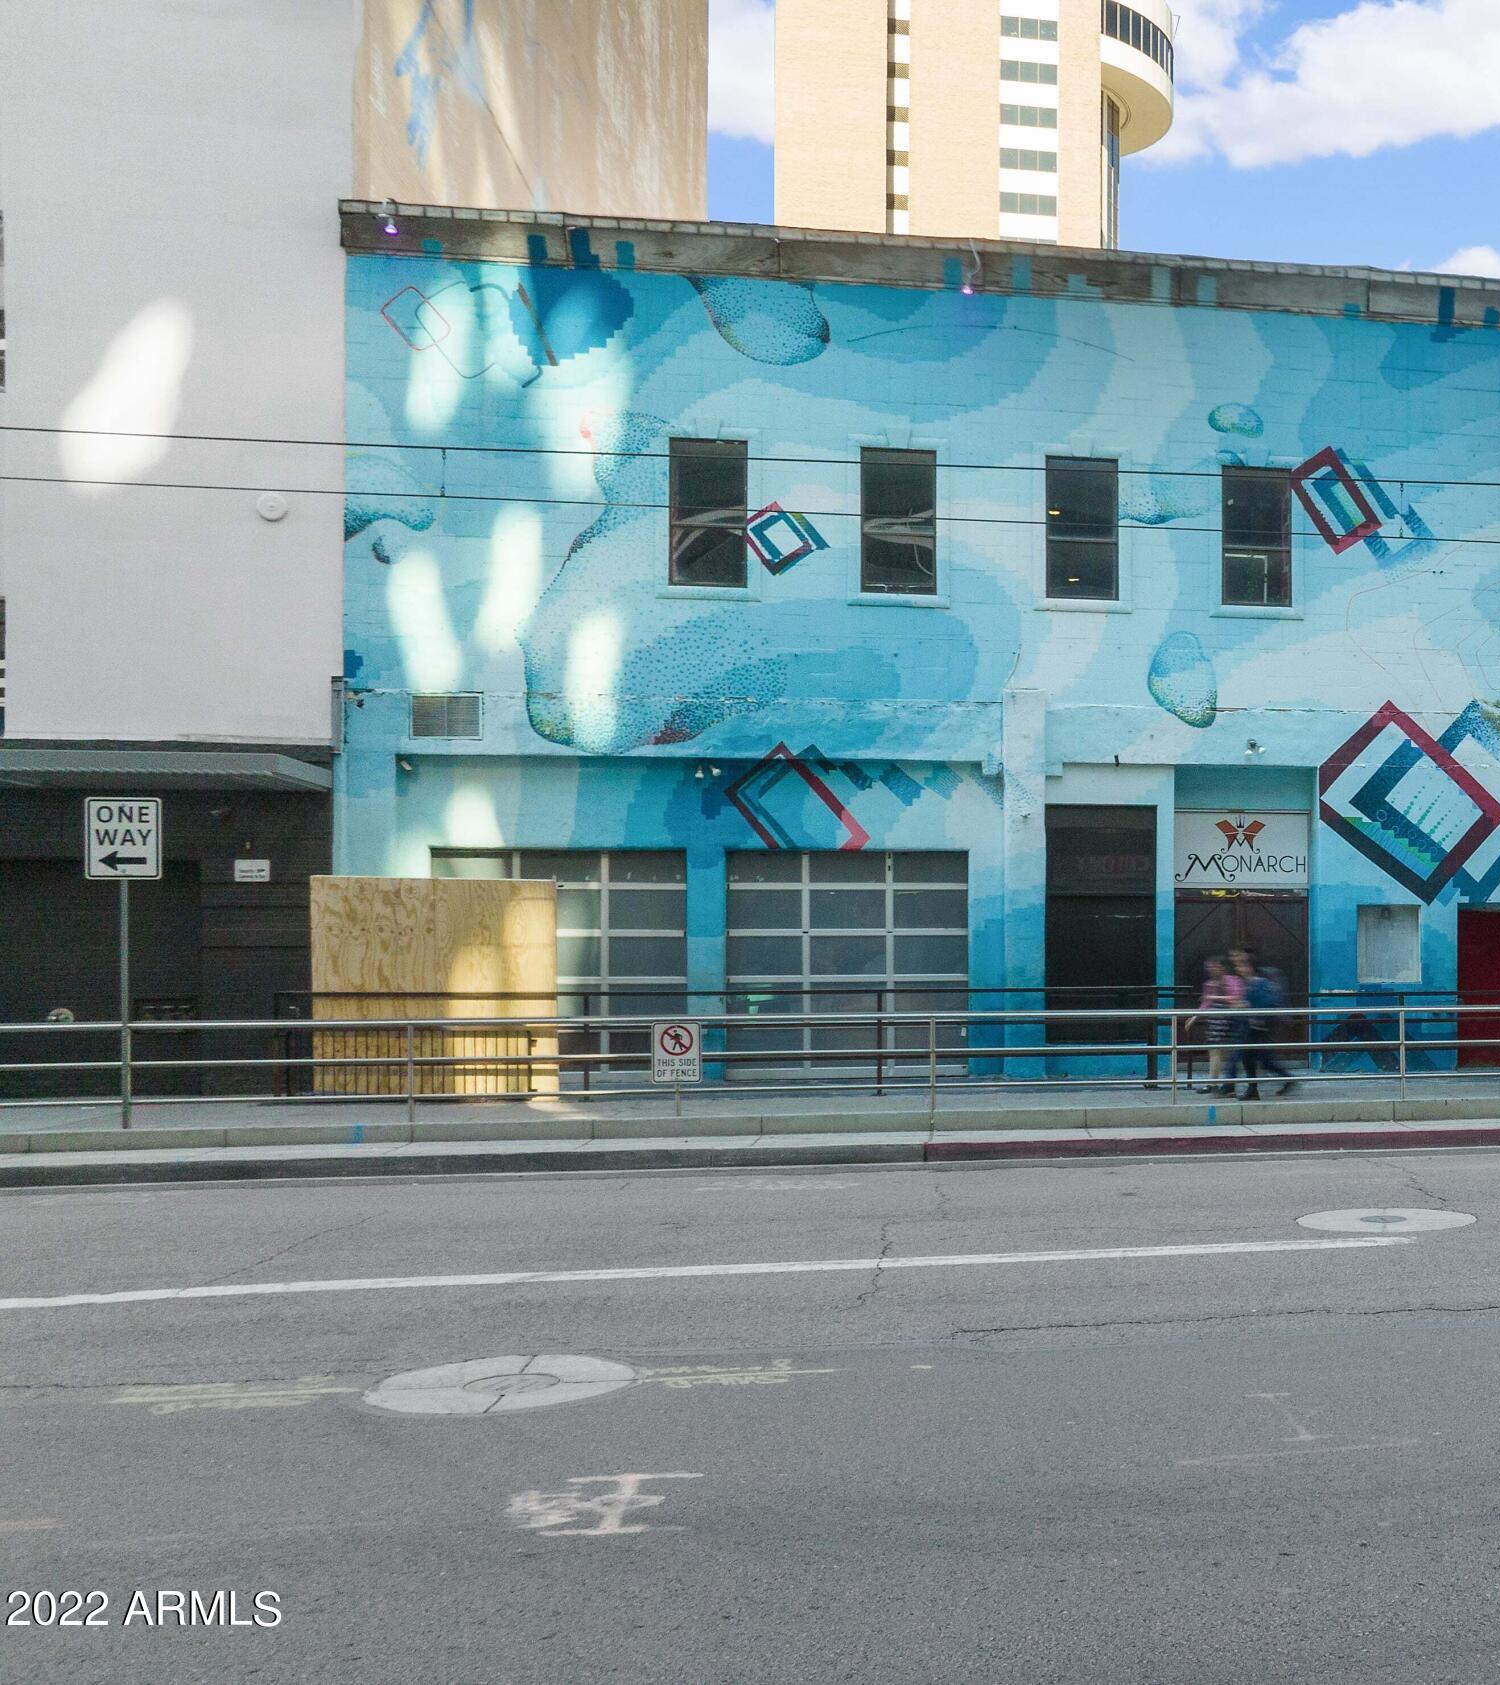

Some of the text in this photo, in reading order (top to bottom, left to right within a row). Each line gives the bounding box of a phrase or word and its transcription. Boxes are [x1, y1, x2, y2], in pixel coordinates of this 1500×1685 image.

[96, 805, 150, 823] ONE
[95, 829, 152, 847] WAY
[1174, 853, 1306, 883] MONARCH
[656, 1058, 697, 1067] THIS SIDE
[656, 1068, 697, 1077] OF FENCE
